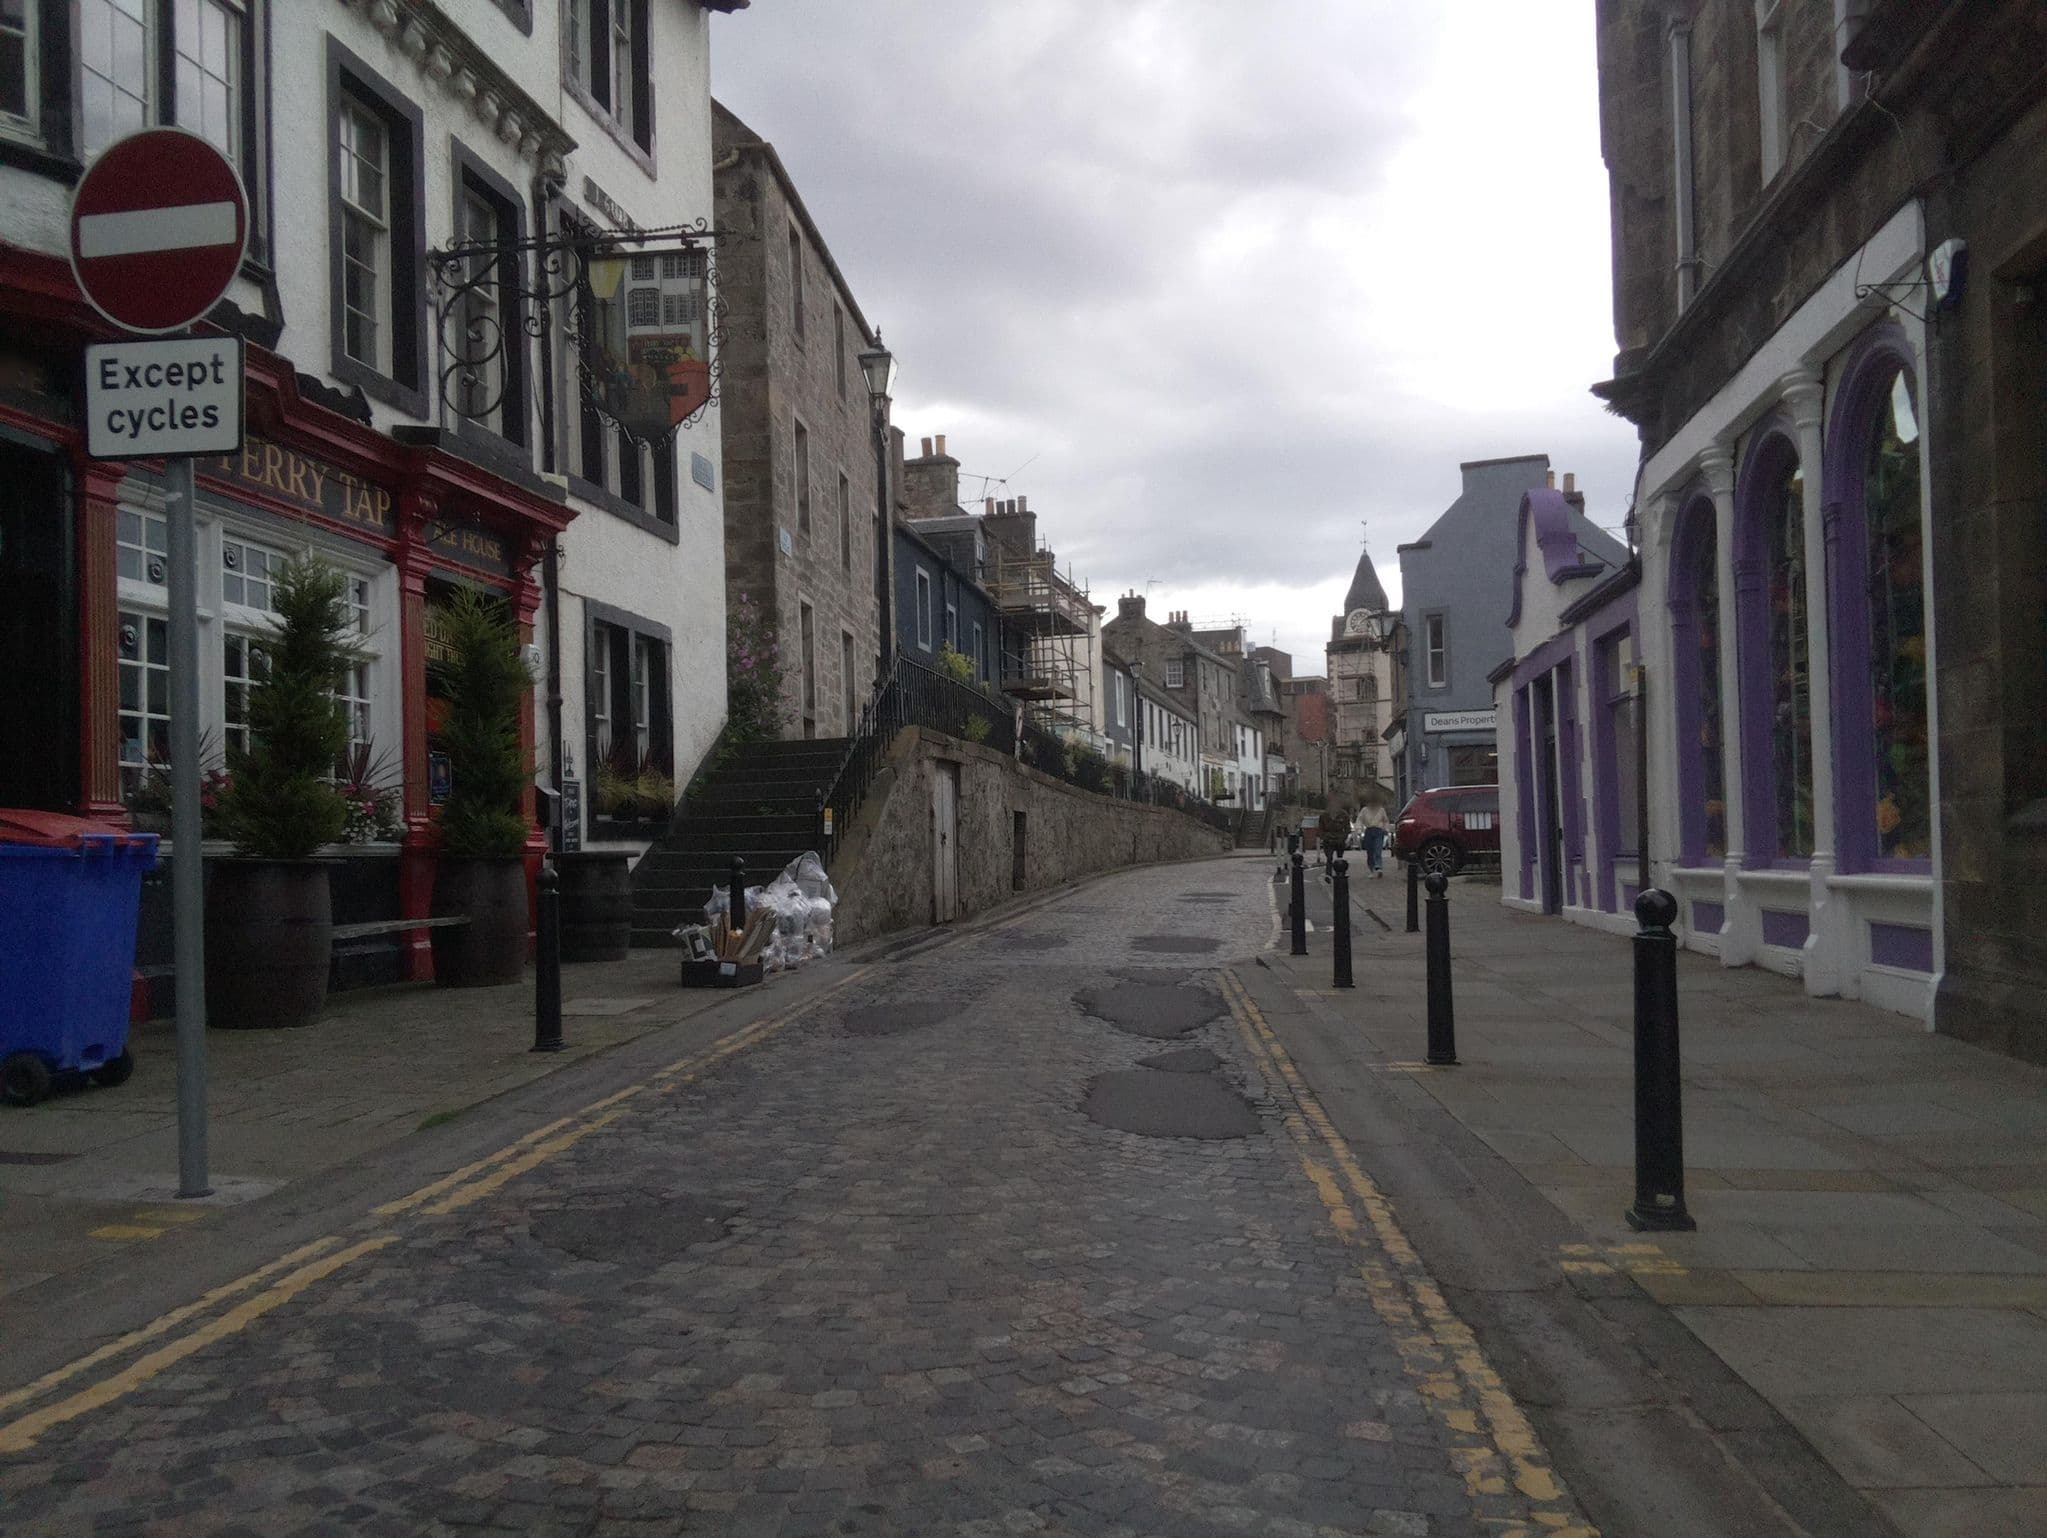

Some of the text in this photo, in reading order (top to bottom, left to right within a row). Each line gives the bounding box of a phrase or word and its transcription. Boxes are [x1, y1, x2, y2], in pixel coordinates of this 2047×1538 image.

[100, 353, 225, 391] Except
[107, 398, 219, 439] cycles
[339, 472, 392, 527] TAP
[431, 520, 502, 561] ALE HOUSE
[1430, 715, 1497, 726] Deans Propert
